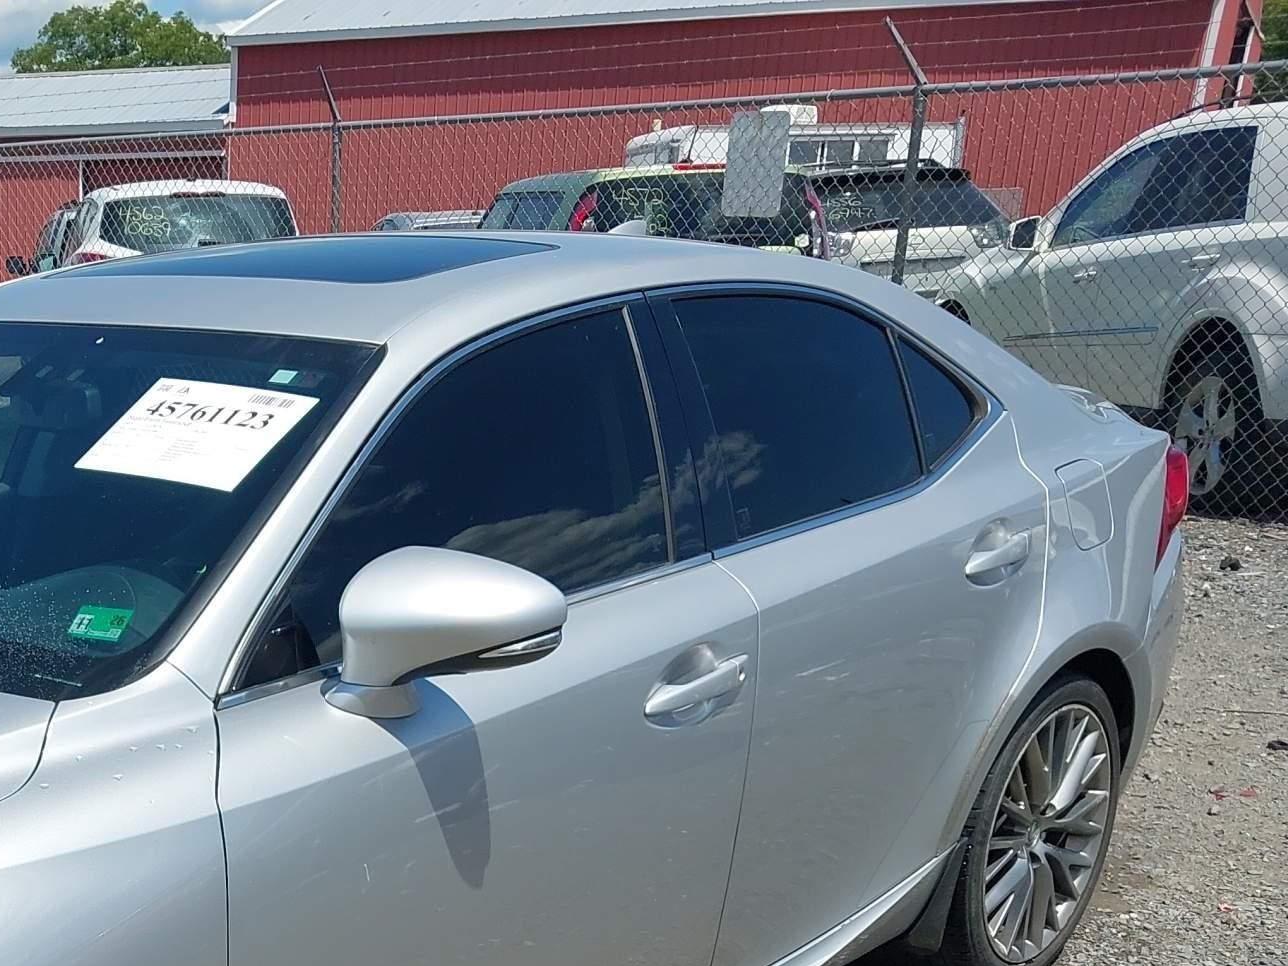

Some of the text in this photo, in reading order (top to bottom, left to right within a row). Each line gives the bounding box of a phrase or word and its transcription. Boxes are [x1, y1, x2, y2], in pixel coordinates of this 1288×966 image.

[120, 205, 169, 223] 4562
[146, 399, 274, 431] 45761123
[109, 614, 127, 627] 26
